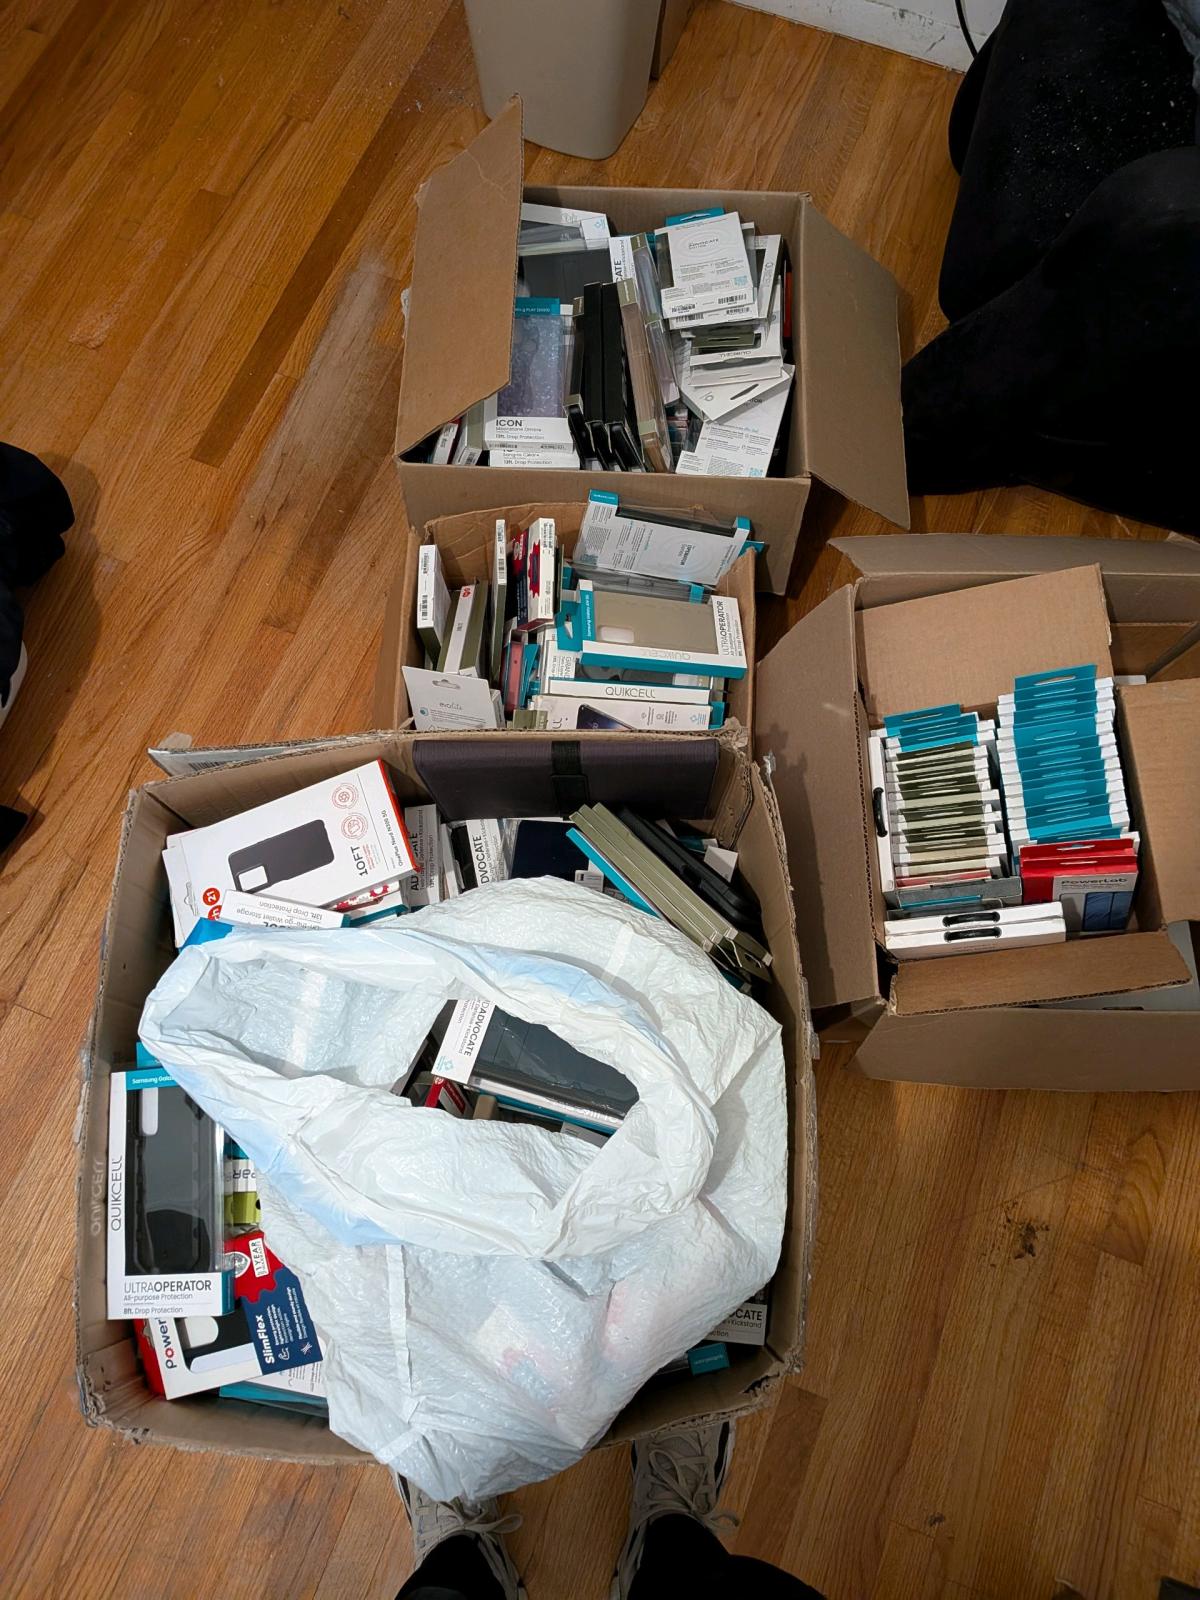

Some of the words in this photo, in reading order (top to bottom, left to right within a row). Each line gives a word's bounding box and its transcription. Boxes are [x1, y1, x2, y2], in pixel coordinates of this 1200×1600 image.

[495, 419, 523, 427] ICON
[717, 600, 730, 656] ULTRAOPERATOR
[605, 686, 656, 699] QUIKCELL
[350, 845, 369, 877] 10FT
[393, 845, 403, 866] OnePlus
[472, 834, 490, 884] DVOCATE
[236, 908, 262, 920] Storage
[259, 901, 292, 914] Protection
[293, 908, 309, 917] Drop
[262, 914, 284, 923] Wallet
[132, 1077, 158, 1085] Samsung
[110, 1155, 122, 1231] QUIKCELL
[252, 1242, 261, 1265] YEAR
[124, 1279, 212, 1294] ULTRAOPERATOR
[160, 1293, 193, 1301] Protection
[134, 1307, 150, 1315] Drop
[151, 1306, 184, 1314] Protection
[255, 1314, 275, 1364] SlimFlex
[710, 1329, 729, 1338] ction
[157, 1317, 178, 1369] power
